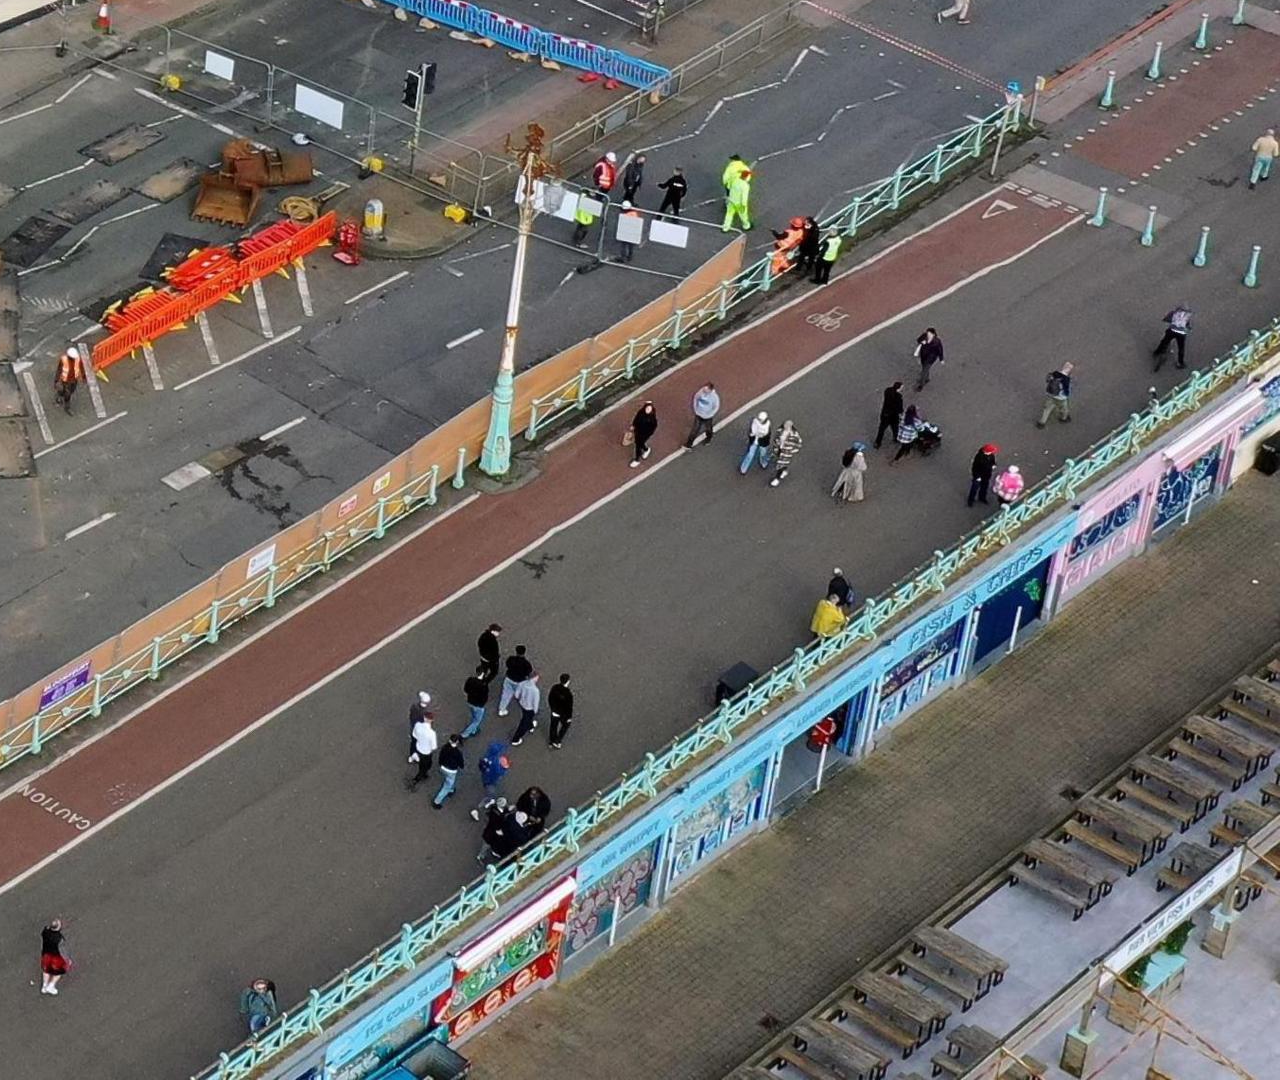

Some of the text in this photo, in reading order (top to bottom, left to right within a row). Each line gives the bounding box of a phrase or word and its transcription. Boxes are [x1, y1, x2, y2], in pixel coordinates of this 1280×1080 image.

[908, 604, 955, 645] FISH
[963, 590, 978, 610] &
[987, 546, 1043, 592] CHIPS
[16, 784, 90, 830] CAUTION
[388, 997, 416, 1025] COLD
